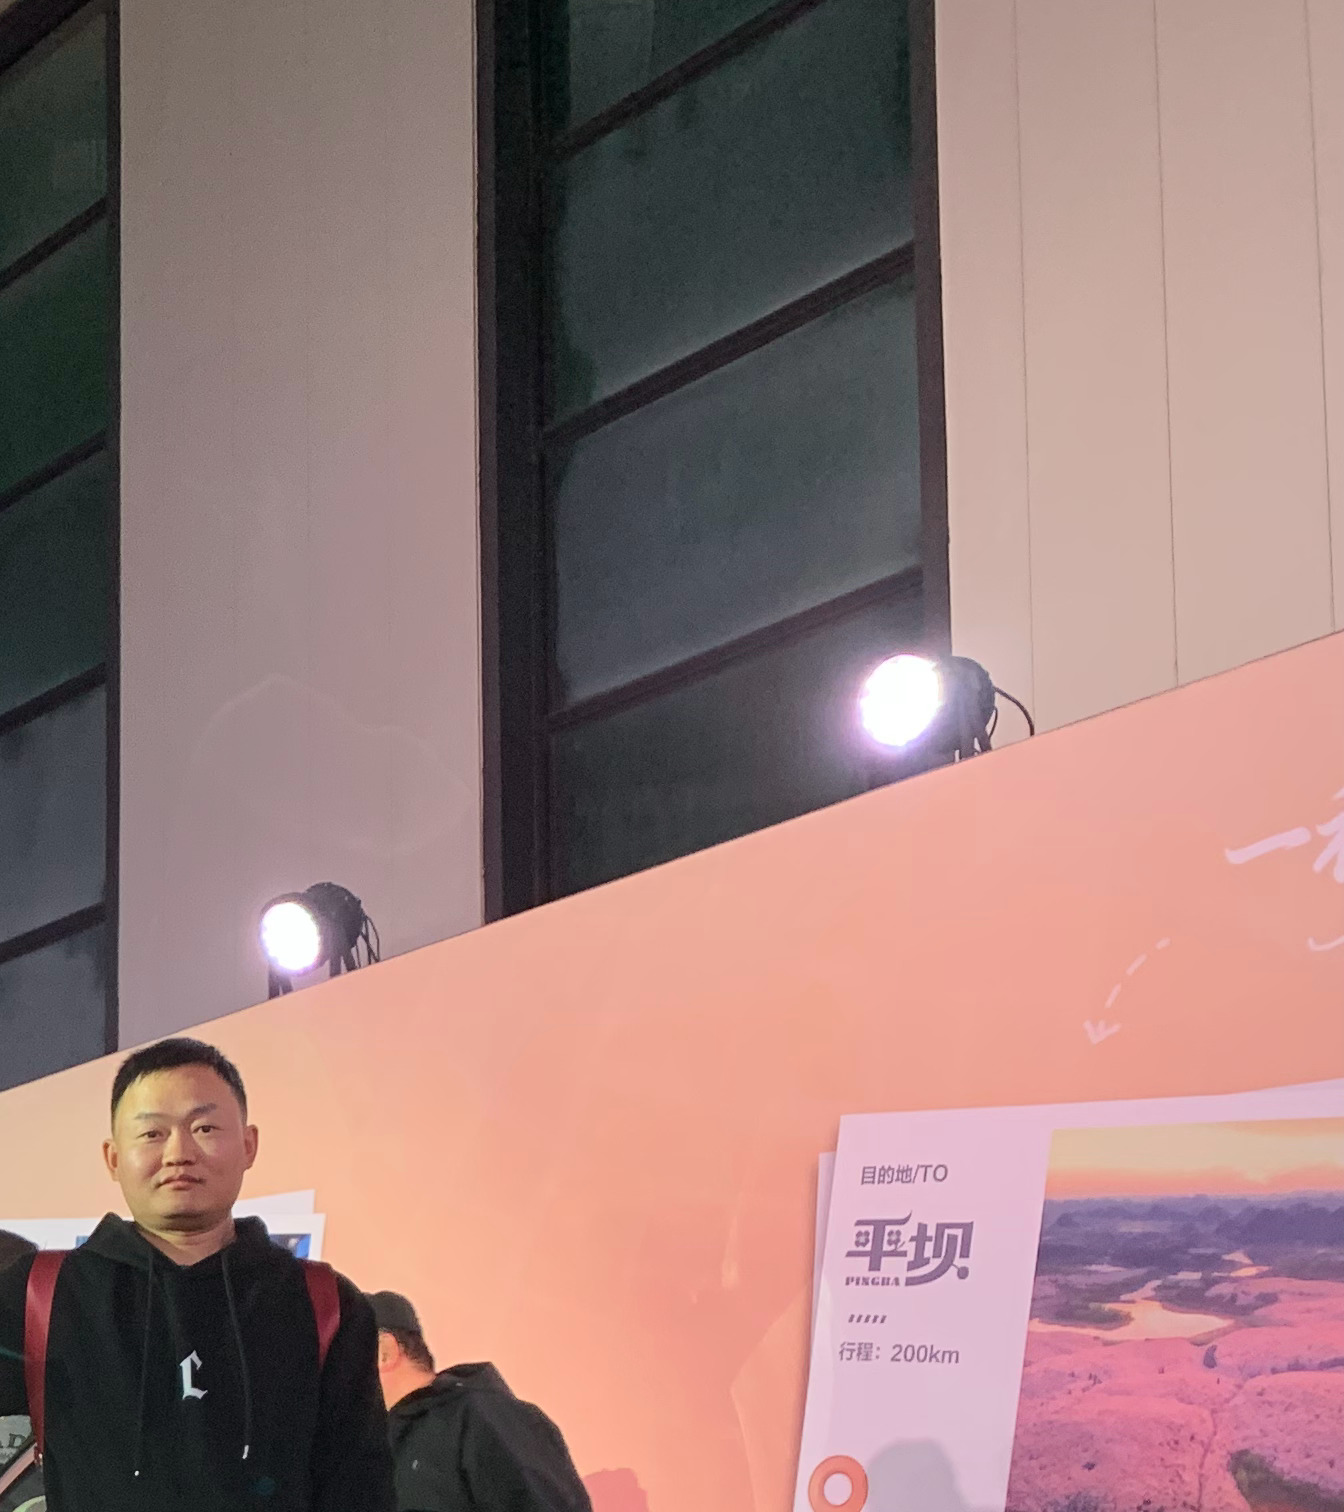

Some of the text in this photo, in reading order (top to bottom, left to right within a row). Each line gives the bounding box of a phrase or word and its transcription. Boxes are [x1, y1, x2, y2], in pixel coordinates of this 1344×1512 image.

[860, 1163, 949, 1186] 目的地/TO
[845, 1210, 975, 1287] 平坝
[845, 1275, 900, 1287] PINGBA
